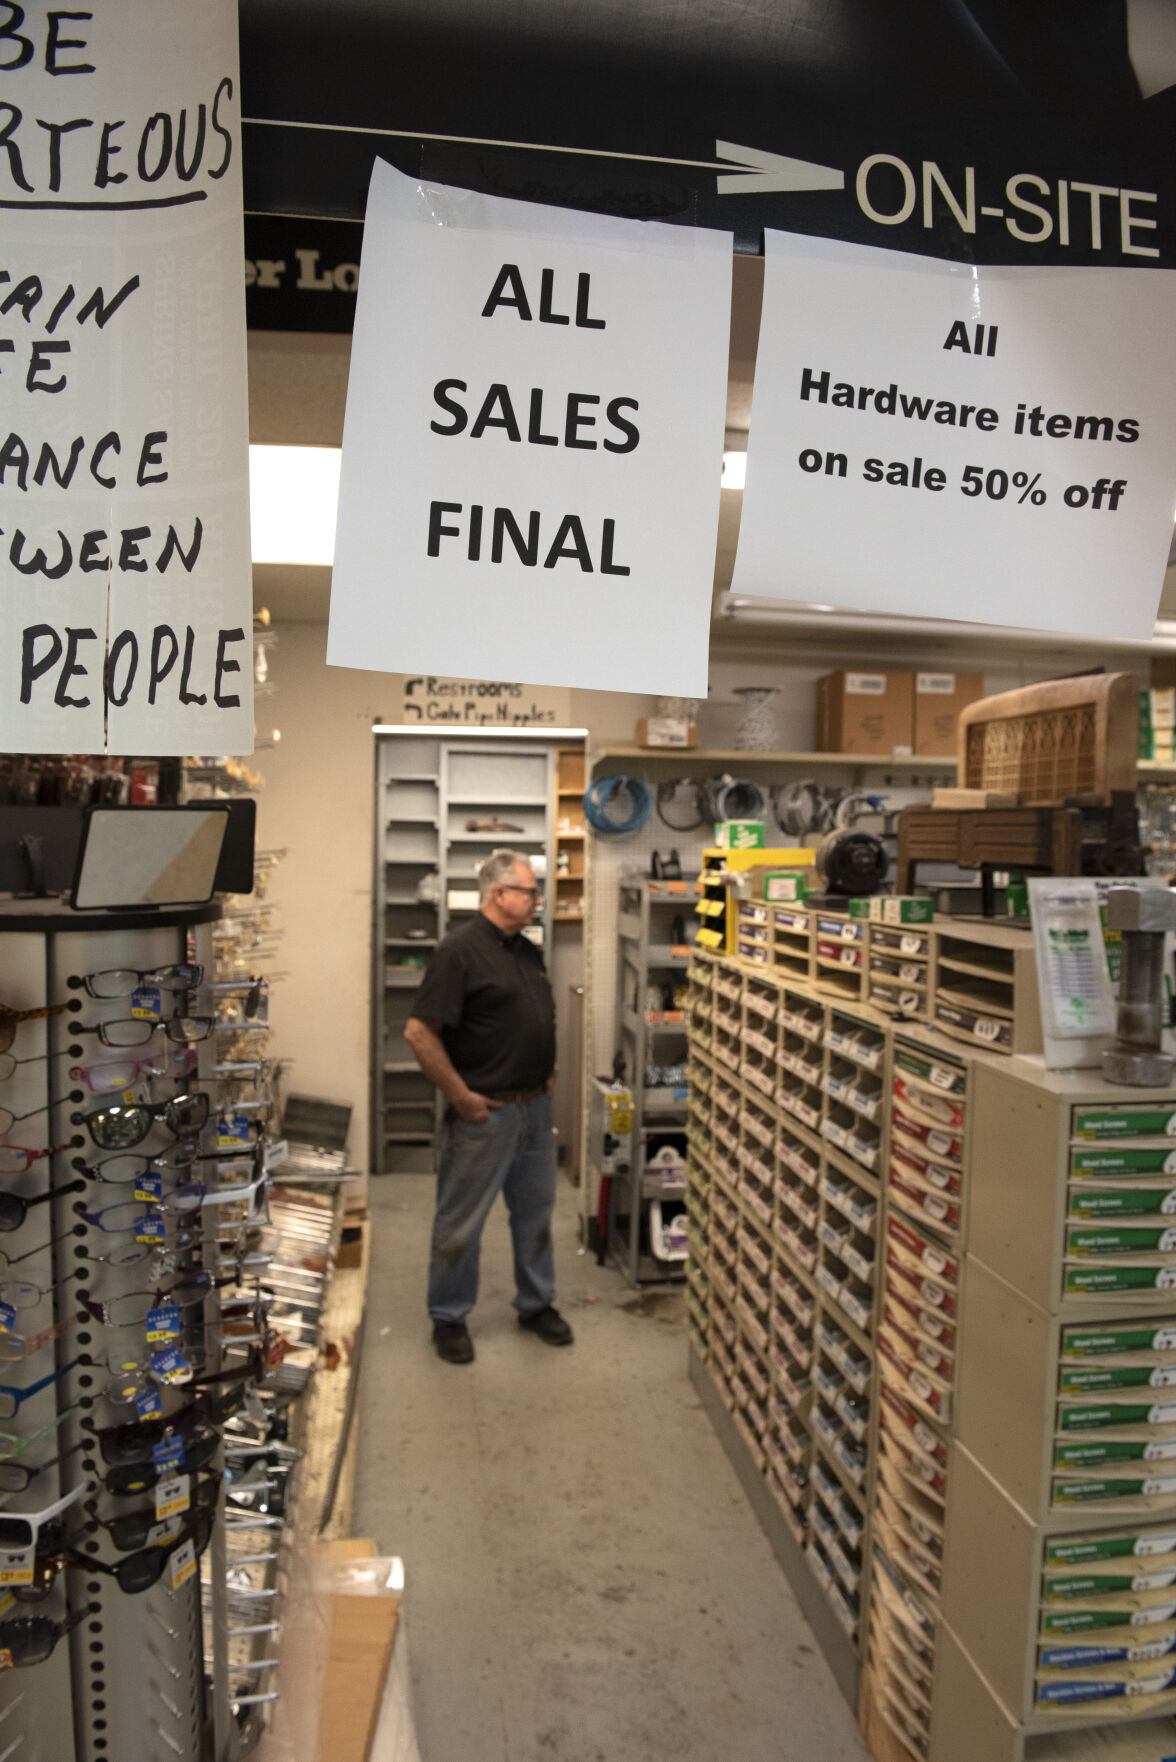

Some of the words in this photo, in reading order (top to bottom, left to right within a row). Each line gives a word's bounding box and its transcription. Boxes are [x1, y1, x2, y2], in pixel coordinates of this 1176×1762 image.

[0, 0, 96, 76] BE
[856, 153, 1160, 258] ON-SITE
[0, 271, 139, 334] AIN
[481, 263, 606, 330] ALL
[943, 320, 998, 357] All
[430, 378, 640, 454] SALES
[800, 367, 999, 432] Hardware
[1014, 403, 1140, 443] items
[0, 431, 168, 492] ANCE
[798, 448, 848, 478] on
[862, 457, 947, 492] sale
[960, 465, 1047, 506] 50%
[1063, 478, 1128, 511] off
[0, 516, 203, 580] WEEN
[427, 500, 631, 577] FINAL
[20, 623, 245, 709] PEOPLE
[427, 676, 522, 698] Restrooms
